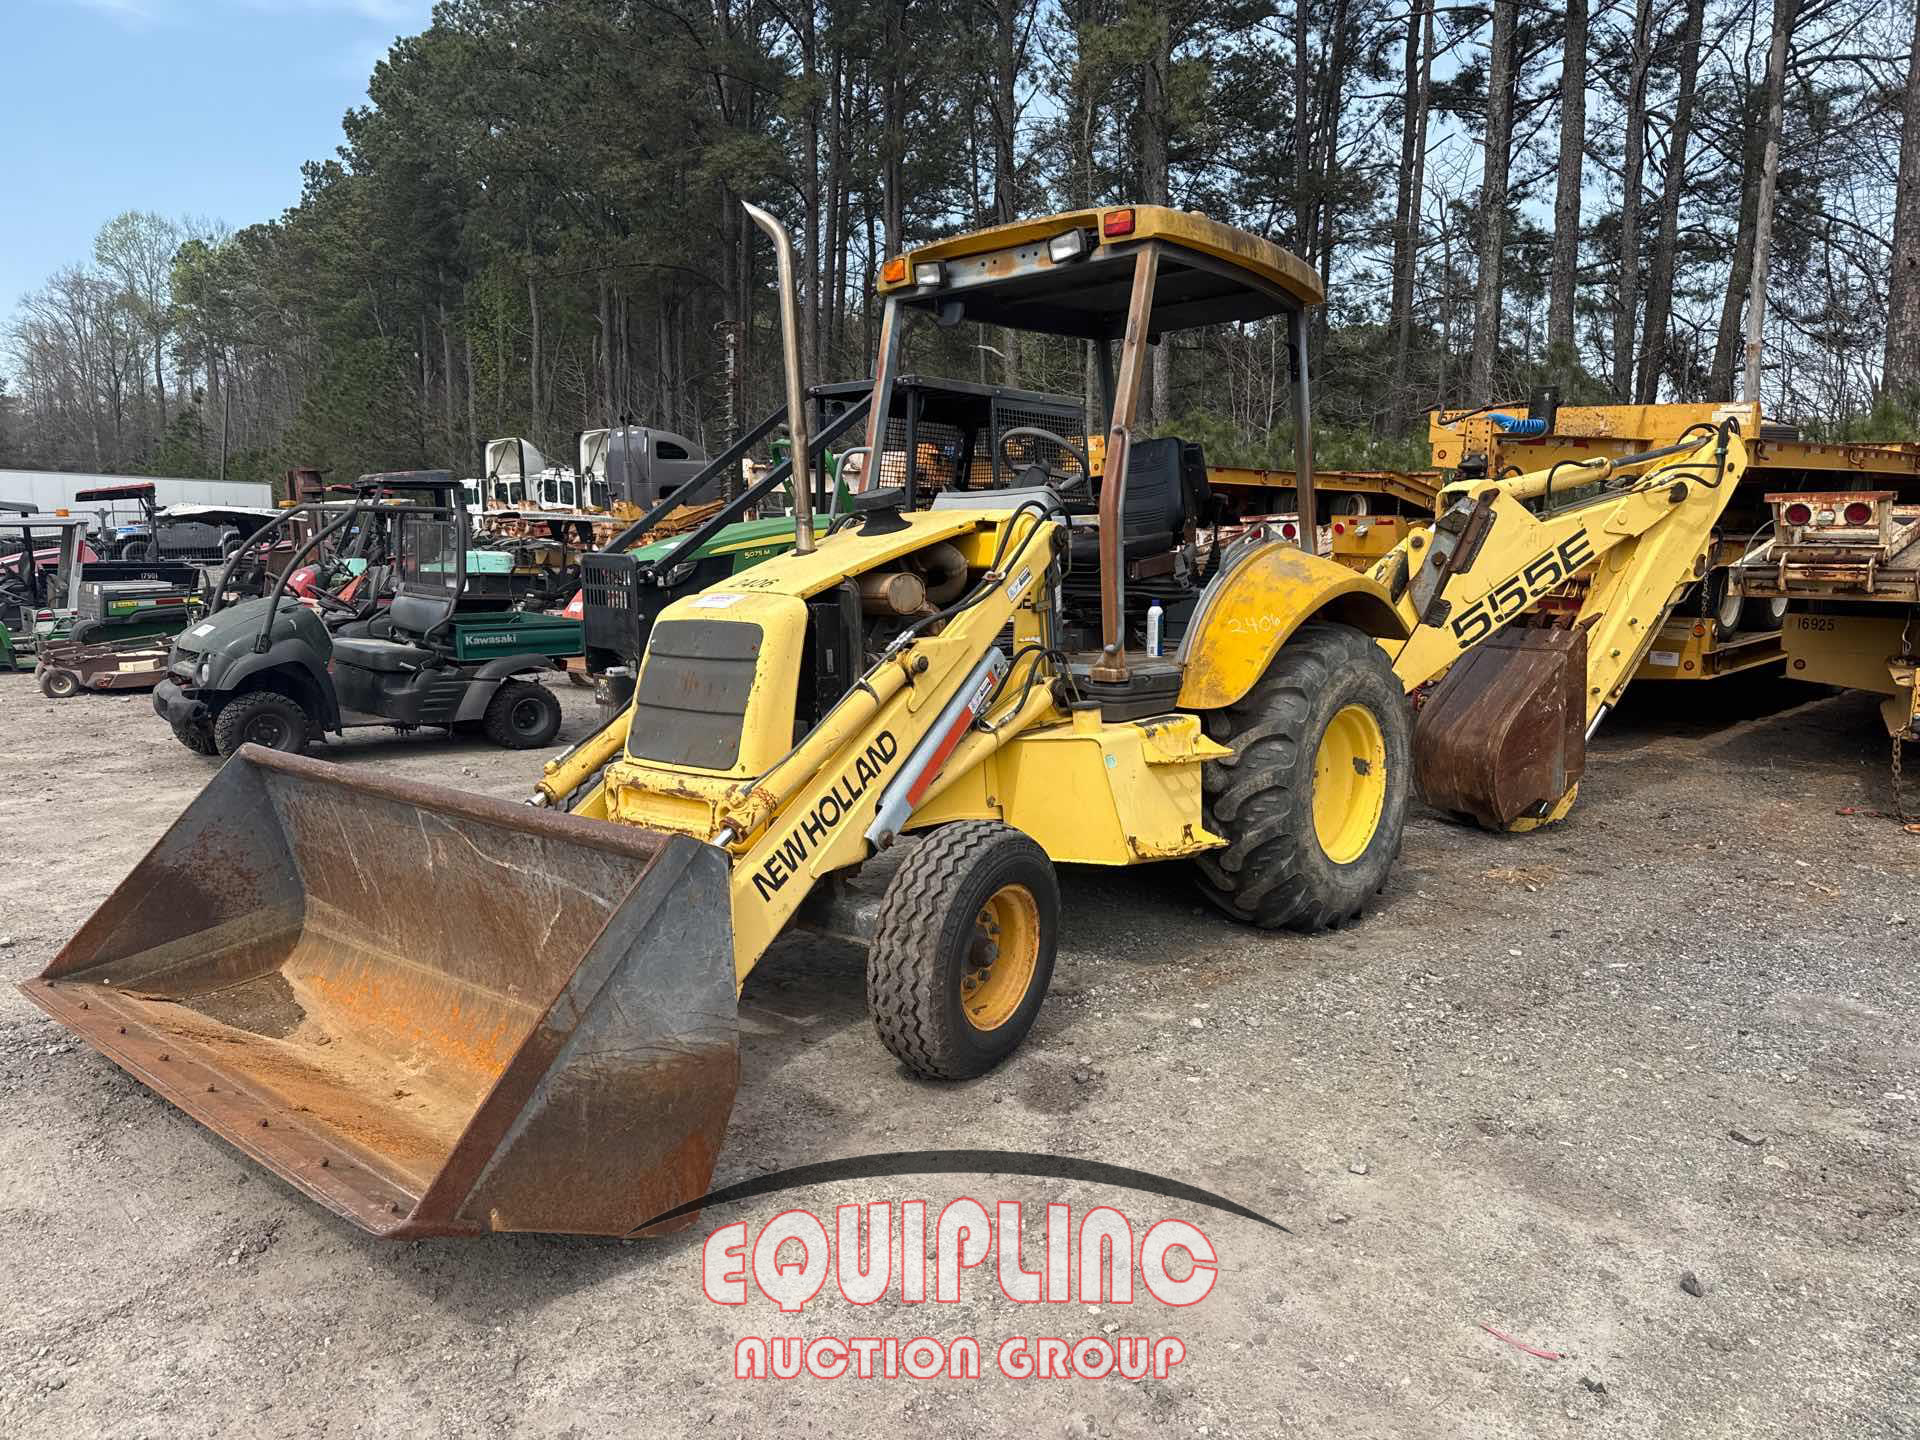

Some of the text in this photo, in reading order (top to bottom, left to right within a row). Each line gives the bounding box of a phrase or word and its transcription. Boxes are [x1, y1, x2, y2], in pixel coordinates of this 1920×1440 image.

[1451, 528, 1596, 649] 555E
[1228, 613, 1281, 634] 2406
[1798, 617, 1834, 631] 16925
[465, 633, 517, 646] Kawasaki
[751, 730, 898, 903] NEW HOLLAND
